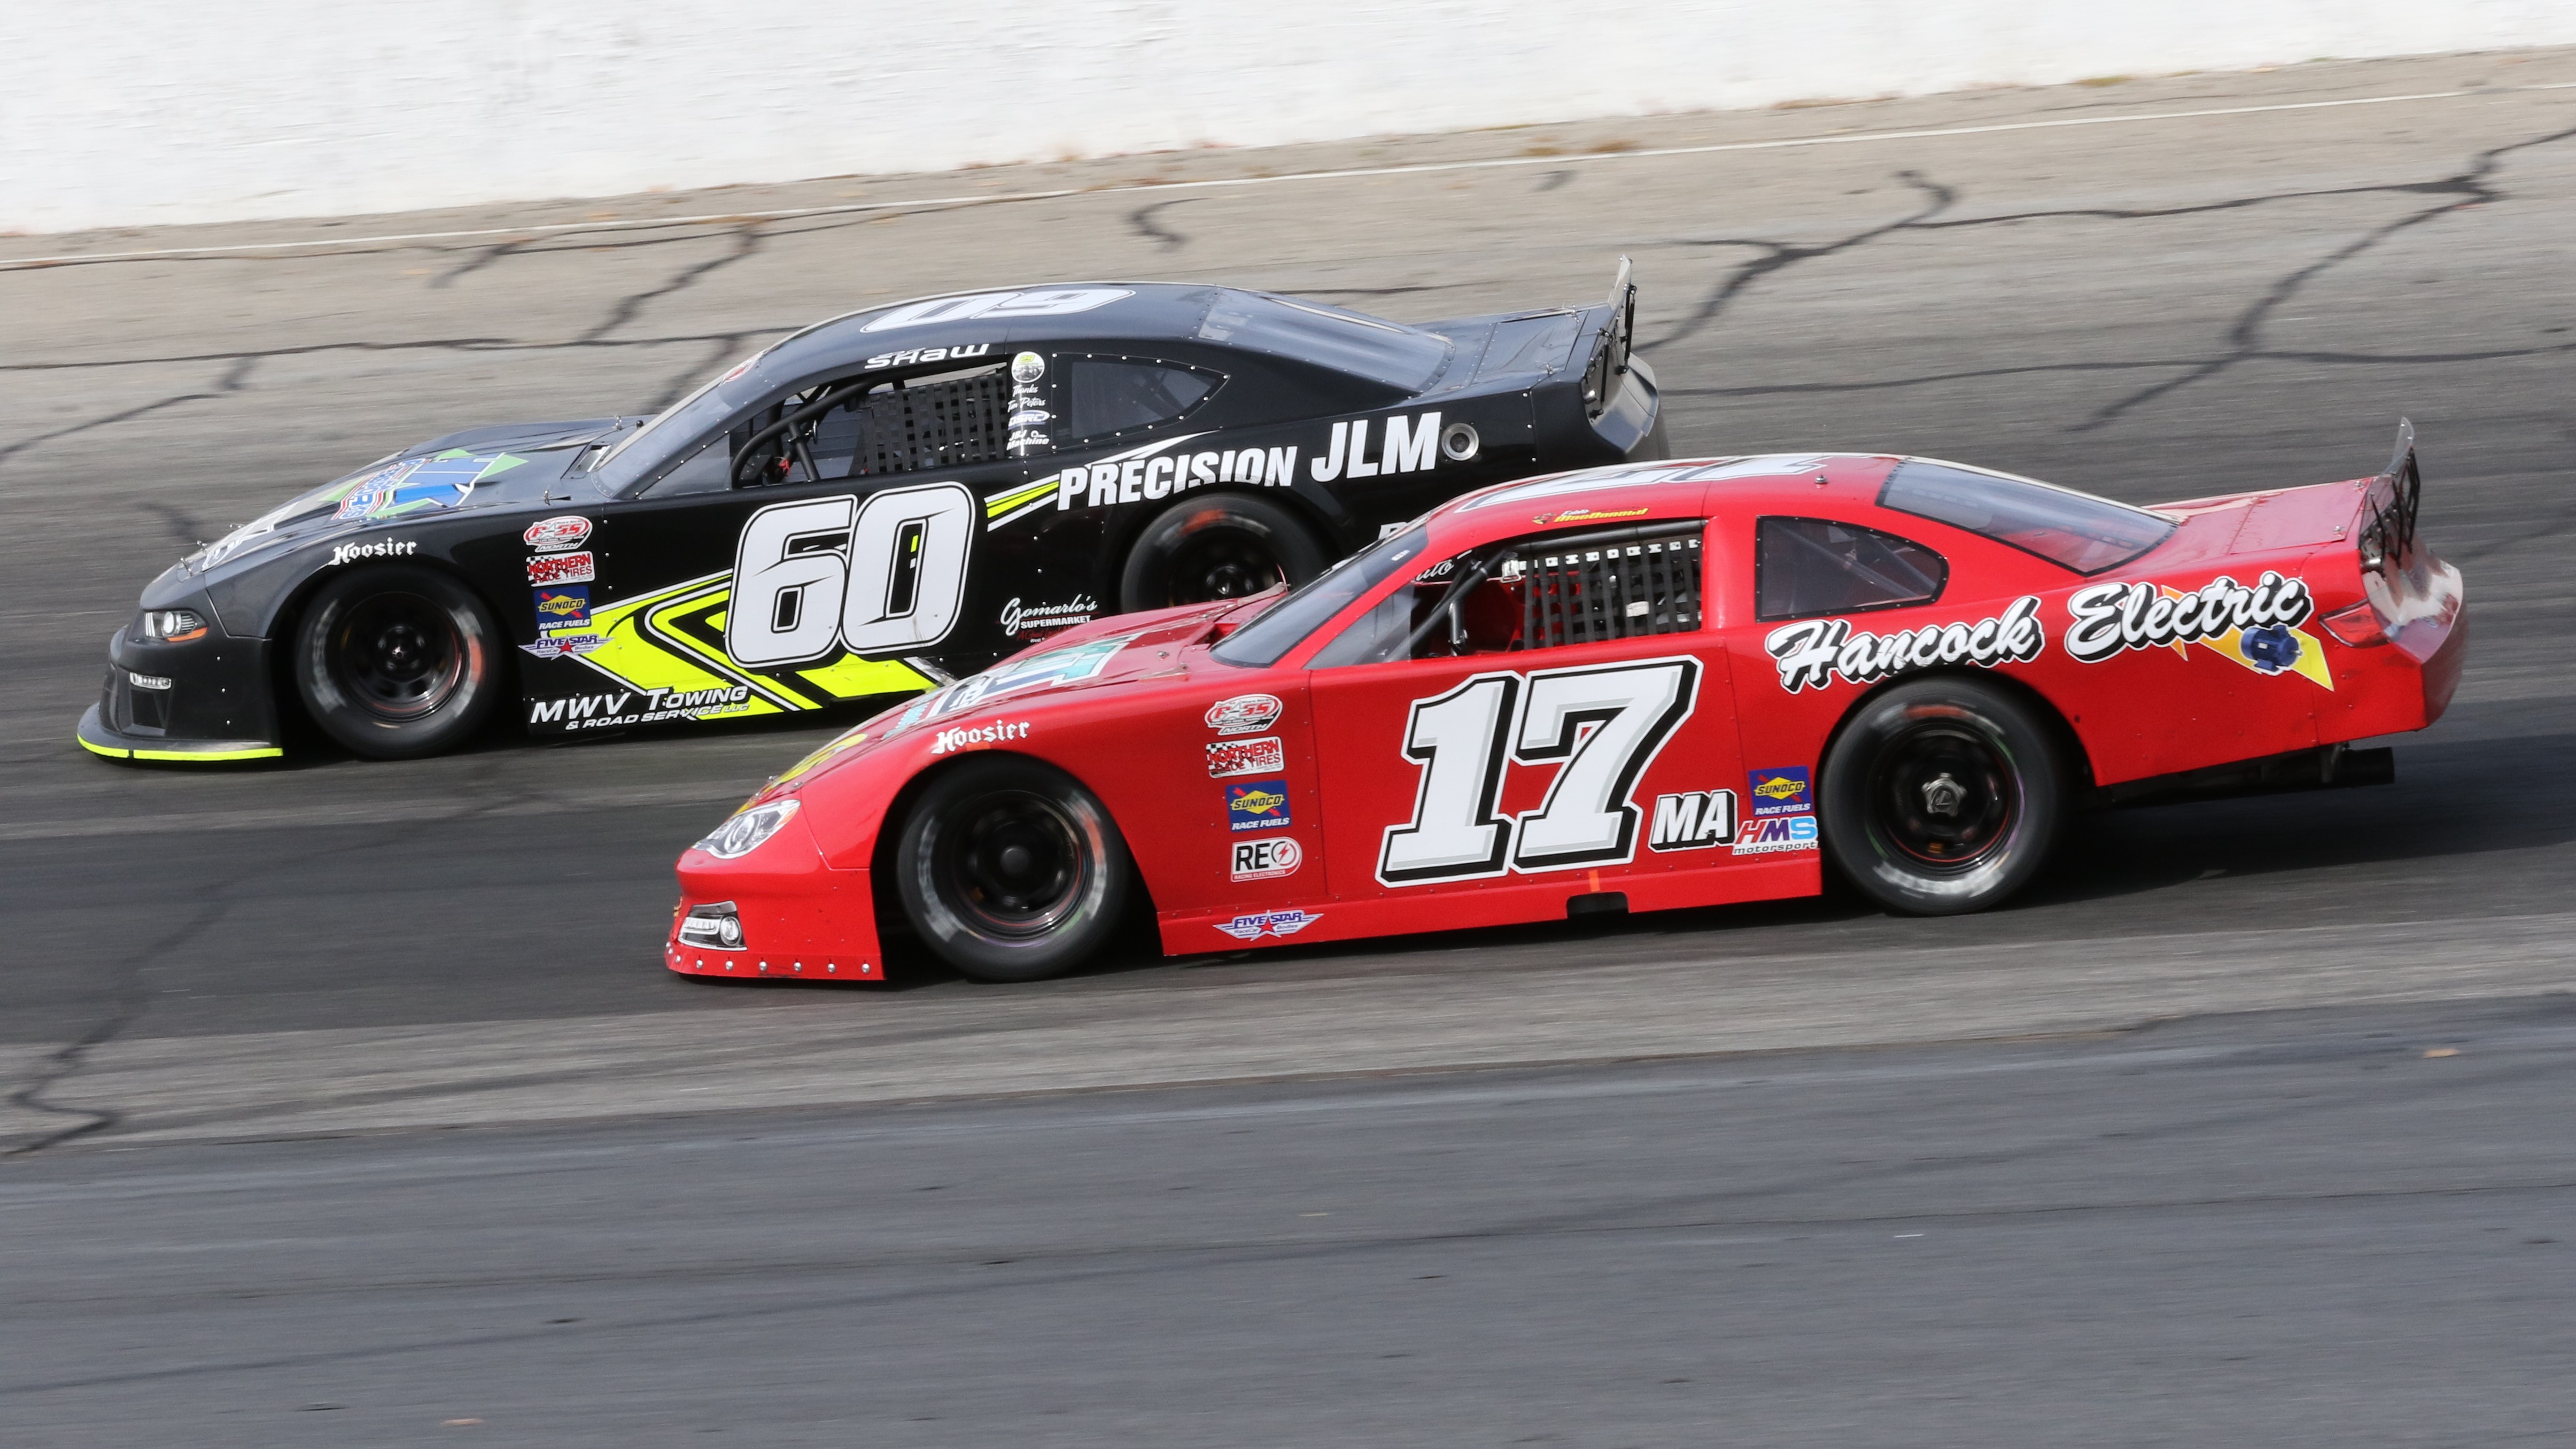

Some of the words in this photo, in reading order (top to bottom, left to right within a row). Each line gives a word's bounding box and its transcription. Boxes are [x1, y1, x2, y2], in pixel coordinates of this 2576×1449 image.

[1013, 384, 1038, 397] Thanks
[1019, 397, 1046, 408] Peters
[1006, 438, 1050, 451] Machine
[1057, 446, 1298, 511] PRECISION
[1310, 411, 1441, 483] JLM
[328, 537, 417, 565] Hoosier
[539, 543, 579, 551] NORTH
[528, 553, 591, 575] NORTHERN
[535, 572, 561, 583] RACE
[564, 565, 593, 578] TIRES
[725, 481, 976, 669] 60
[540, 599, 583, 611] SUNOCO
[1000, 593, 1098, 636] Gomarlo's
[1021, 615, 1091, 629] SUPERMARKET
[539, 621, 563, 630] RACE
[564, 618, 590, 627] FUELS
[1765, 596, 2044, 694] Hancock
[2065, 570, 2315, 664] Electric
[537, 638, 564, 649] FIVE
[570, 635, 597, 644] STAR
[530, 692, 631, 724] MWV
[565, 721, 579, 730] &
[583, 715, 640, 729] ROAD
[641, 705, 722, 722] SERVICE
[723, 704, 749, 713] LLC
[931, 719, 1030, 754] Hoosier
[1224, 725, 1267, 733] NORTH
[1209, 739, 1279, 764] NORTHERN
[1215, 760, 1246, 773] RACE
[1251, 753, 1281, 768] TIRES
[1375, 654, 1704, 888] 17
[1757, 782, 1804, 796] SUNOCO
[1233, 796, 1282, 809] SUNOCO
[1755, 805, 1782, 816] RACE
[1783, 803, 1811, 813] FUELS
[1231, 820, 1259, 830] RACE
[1260, 817, 1290, 827] FUELS
[1650, 789, 1735, 851] MA
[1736, 816, 1818, 844] HMS
[1234, 916, 1267, 929] FIVE
[1271, 912, 1302, 923] STAR
